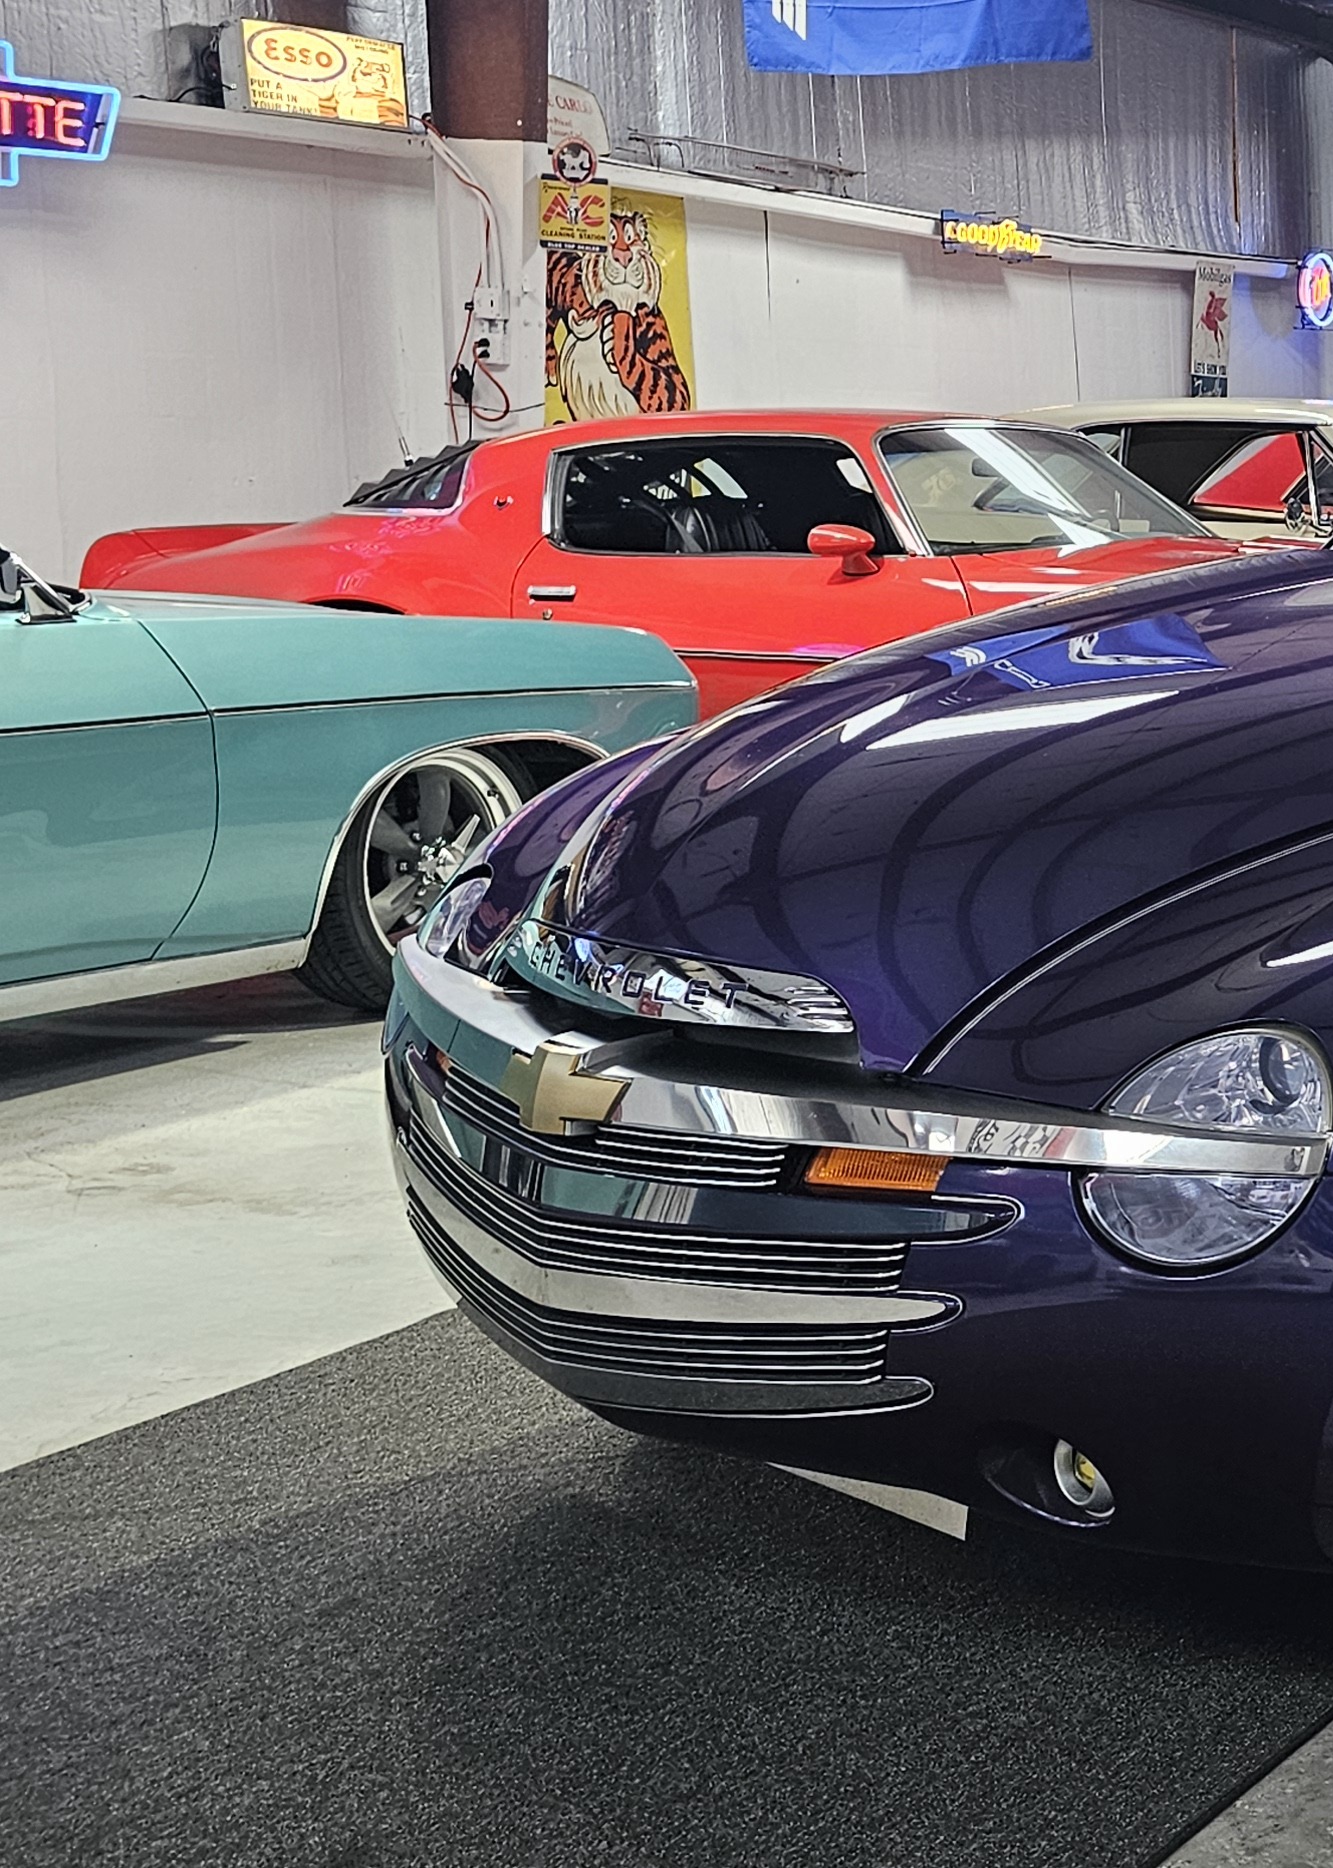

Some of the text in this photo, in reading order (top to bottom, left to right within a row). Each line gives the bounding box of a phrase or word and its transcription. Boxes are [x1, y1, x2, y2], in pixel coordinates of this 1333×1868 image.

[250, 78, 283, 90] PUT A
[251, 88, 298, 102] TIGER IN
[252, 100, 282, 112] YOUR
[542, 192, 606, 228] AC
[528, 940, 749, 1010] CHEVROLET
